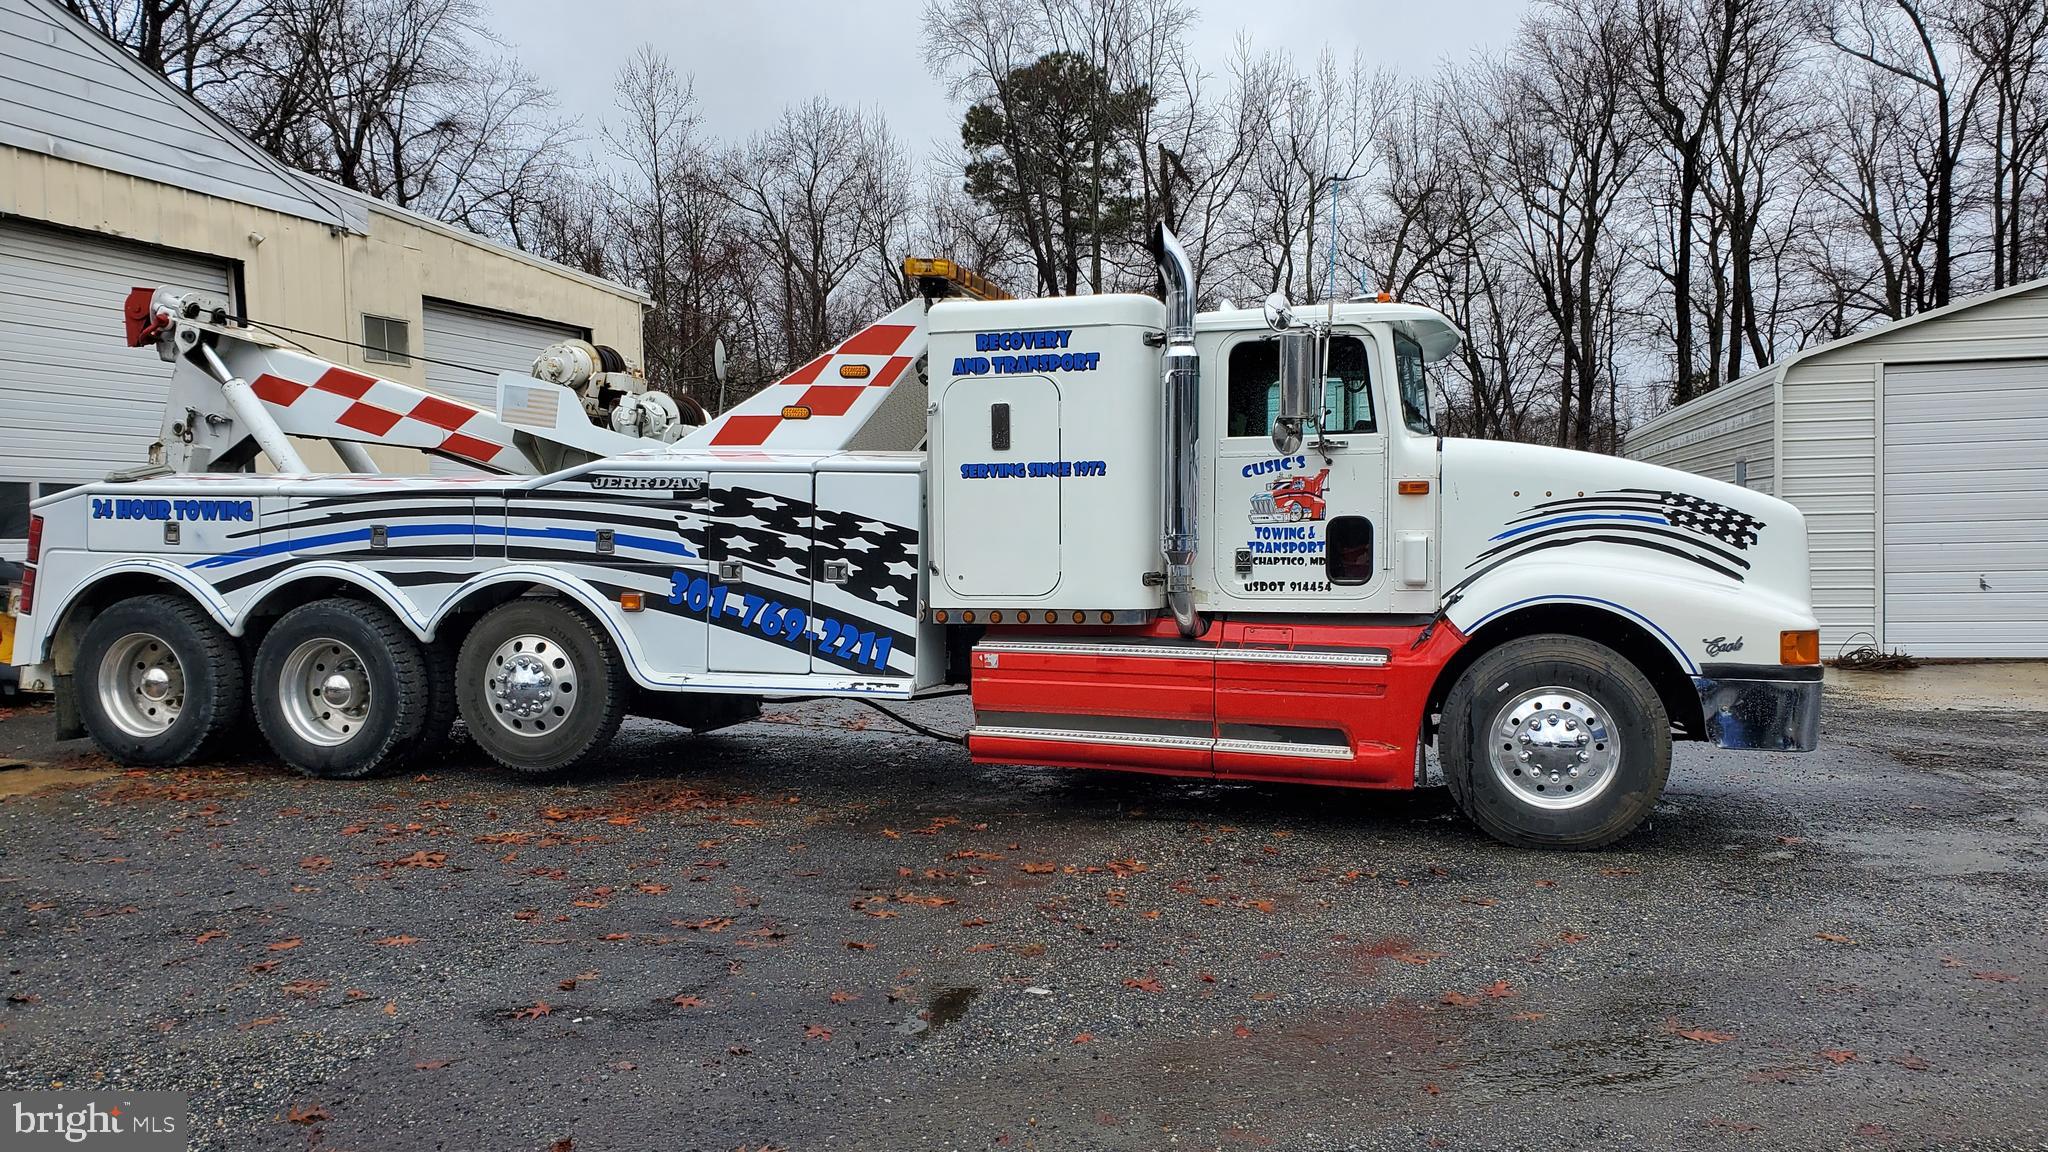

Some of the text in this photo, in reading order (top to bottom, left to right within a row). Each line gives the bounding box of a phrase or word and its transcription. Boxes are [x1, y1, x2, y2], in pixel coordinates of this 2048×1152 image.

[975, 330, 1073, 352] RECOVERY
[952, 352, 1101, 375] AND TRANSPORT
[960, 461, 1107, 479] SERVING SINCE 1972
[1241, 455, 1306, 478] CUSIC'S
[92, 498, 254, 522] 24 HOUR TOWING
[1255, 525, 1316, 540] TOWING &
[1247, 541, 1326, 554] TRANSPORT
[1252, 556, 1327, 567] CHAPTICO, MD
[1289, 581, 1332, 592] 914454
[668, 570, 893, 671] 301-769-2211
